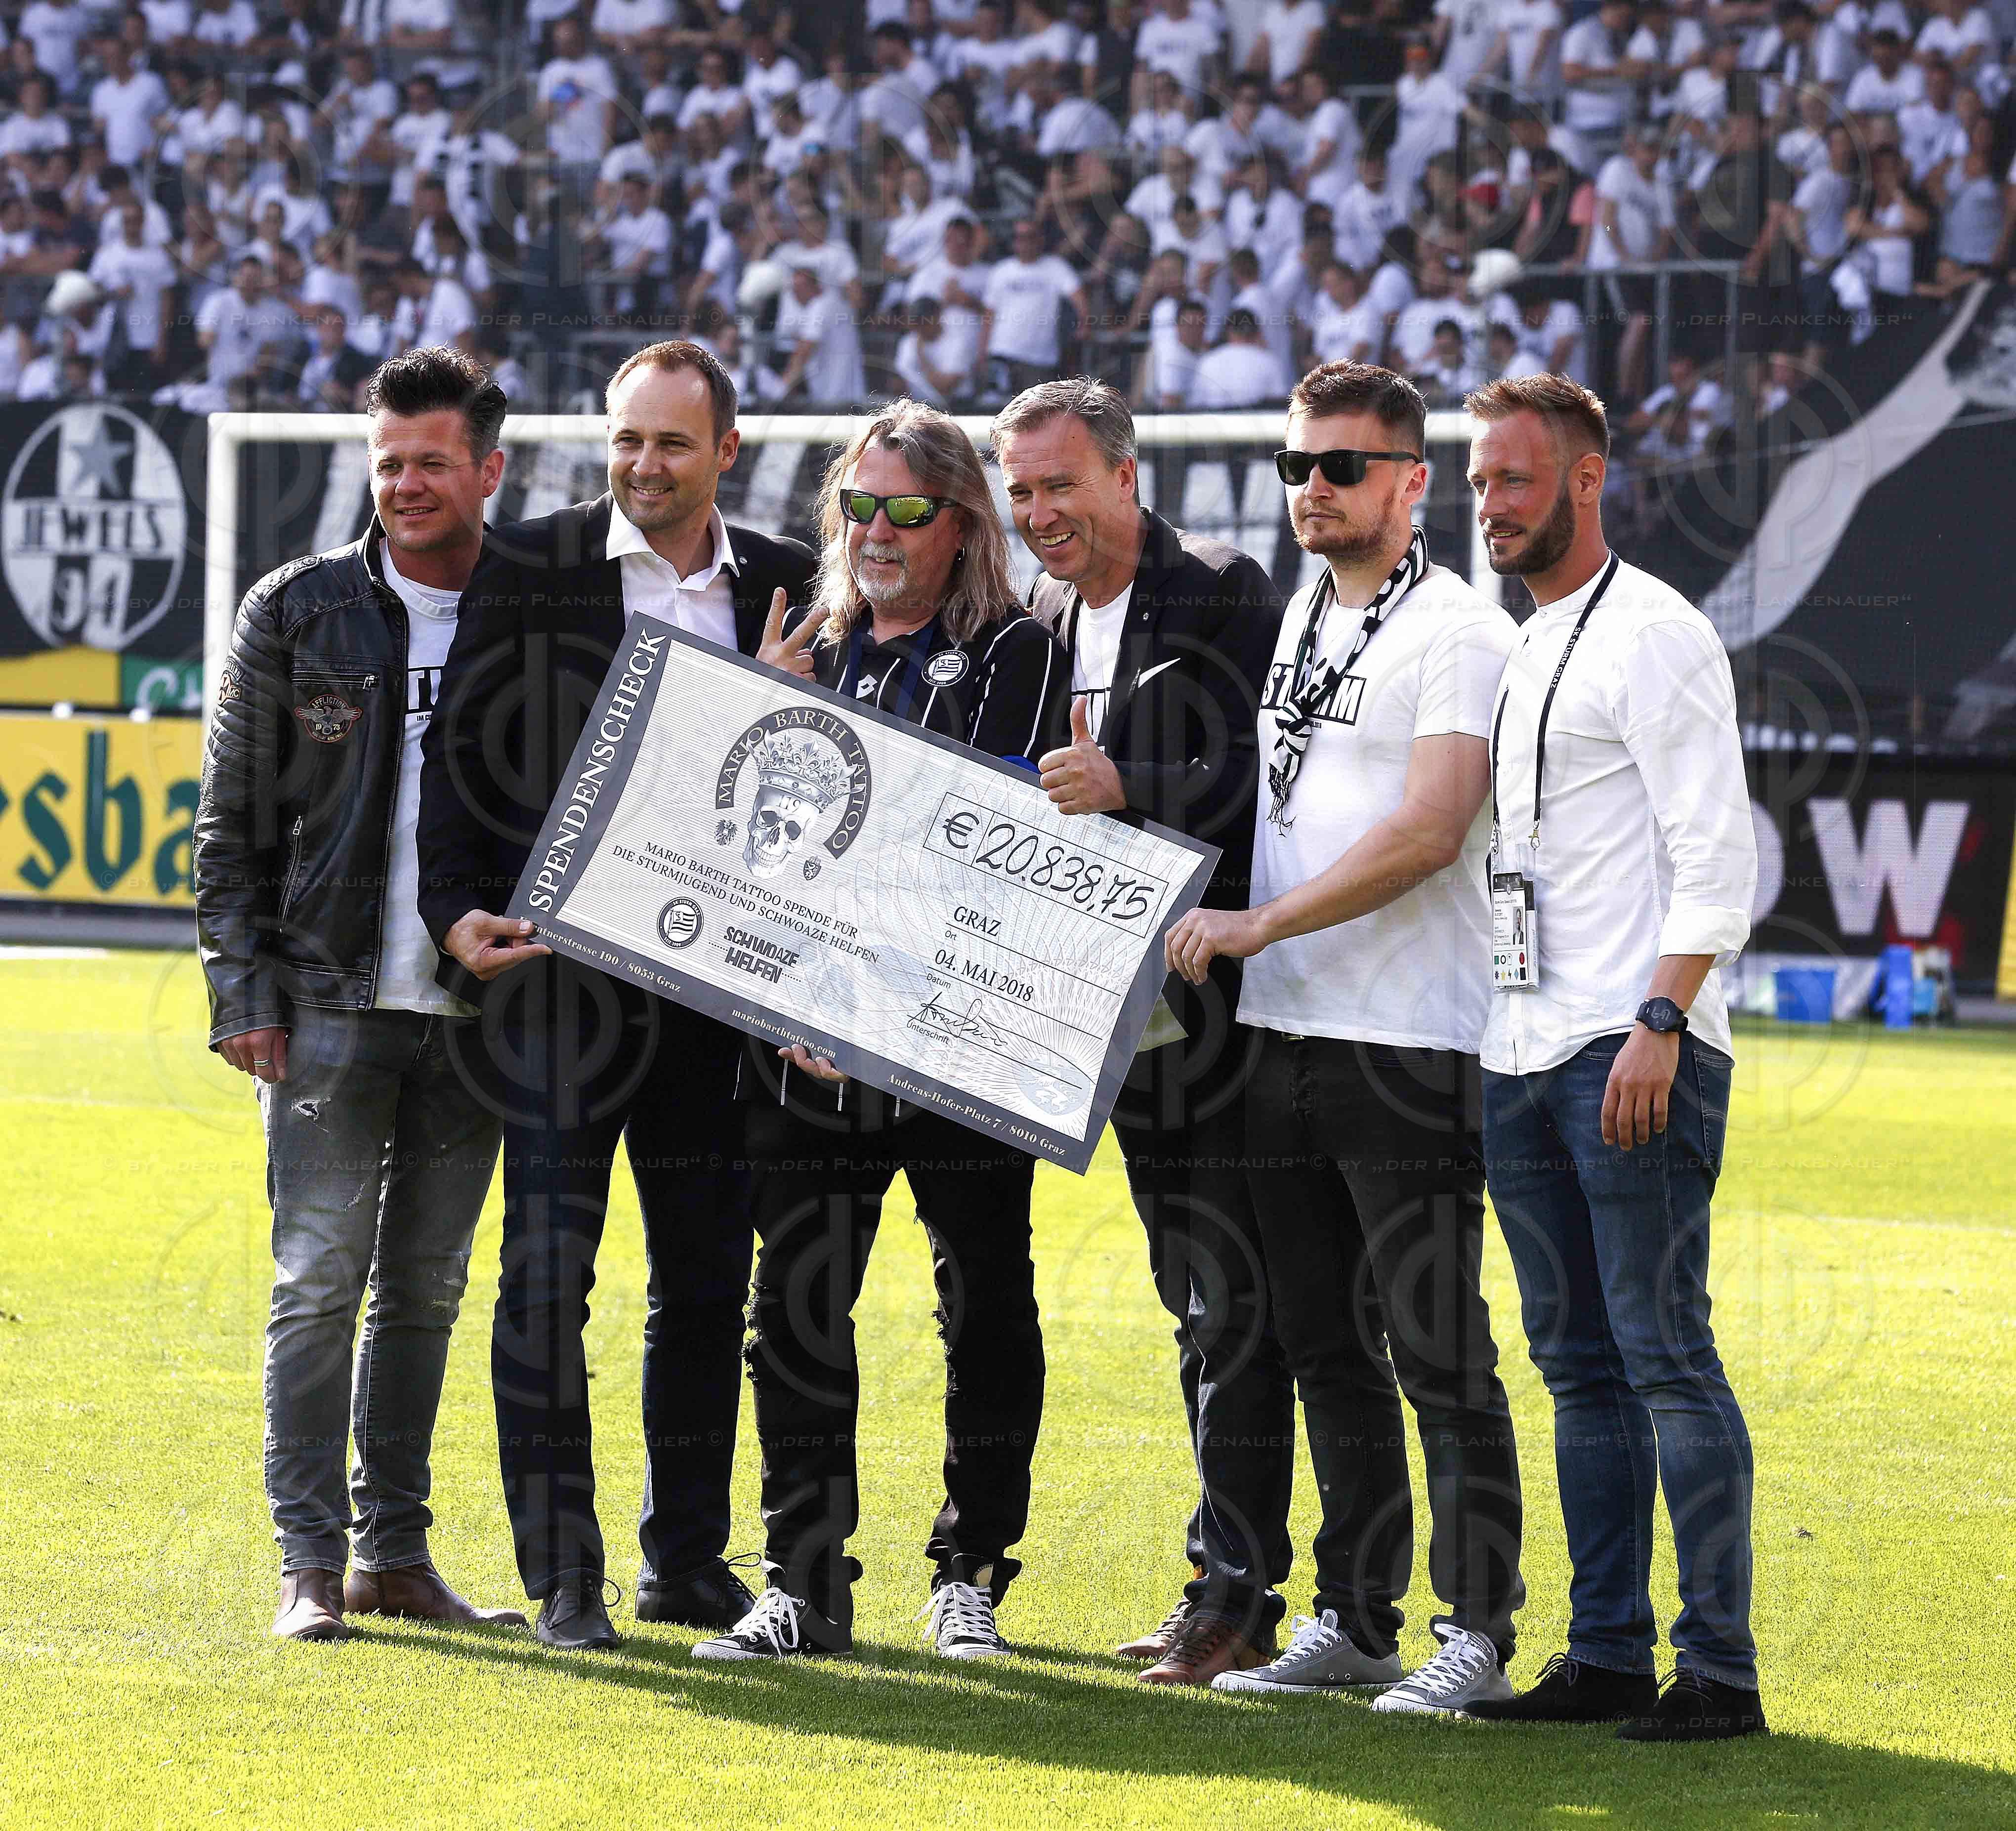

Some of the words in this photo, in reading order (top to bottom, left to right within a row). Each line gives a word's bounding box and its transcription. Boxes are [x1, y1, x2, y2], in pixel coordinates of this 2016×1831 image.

[1572, 626, 1581, 636] SK
[1559, 638, 1576, 665] STURM
[1550, 666, 1563, 689] GRAZ
[311, 696, 346, 709] AFFLICTION
[528, 628, 667, 913] SPENDENSCHECK
[719, 726, 763, 803] MARIO
[774, 710, 849, 742] BARTH
[832, 742, 868, 850] TATTOO
[612, 845, 634, 862] DIE
[636, 855, 727, 901] STURMJUGEND
[729, 893, 757, 913] UND
[757, 905, 828, 943] SCHWOAZE
[829, 936, 881, 964] HELFEN
[644, 842, 687, 866] MARIO
[688, 860, 730, 886] BARTH
[732, 877, 781, 906] TATTOO
[783, 899, 832, 927] SPENDE
[834, 919, 858, 938] FÜR
[945, 930, 958, 941] Ort
[954, 906, 1002, 937] GRAZ
[724, 926, 800, 968] SCHWOAZE
[724, 947, 783, 984] HELFEN
[598, 950, 620, 965] 190
[627, 961, 655, 981] 8053
[656, 974, 682, 993] Graz
[926, 973, 951, 989] Datum
[935, 949, 956, 971] 04.
[961, 959, 999, 987] MAI
[997, 975, 1034, 1002] 2018
[731, 1008, 837, 1059] mariobarthtattoo.com
[906, 1021, 950, 1045] Unterschrift
[886, 1074, 992, 1125] Andreas-Hofer-Platz
[992, 1118, 1003, 1129] 7
[1009, 1124, 1038, 1143] 8010
[1039, 1137, 1066, 1156] Graz
